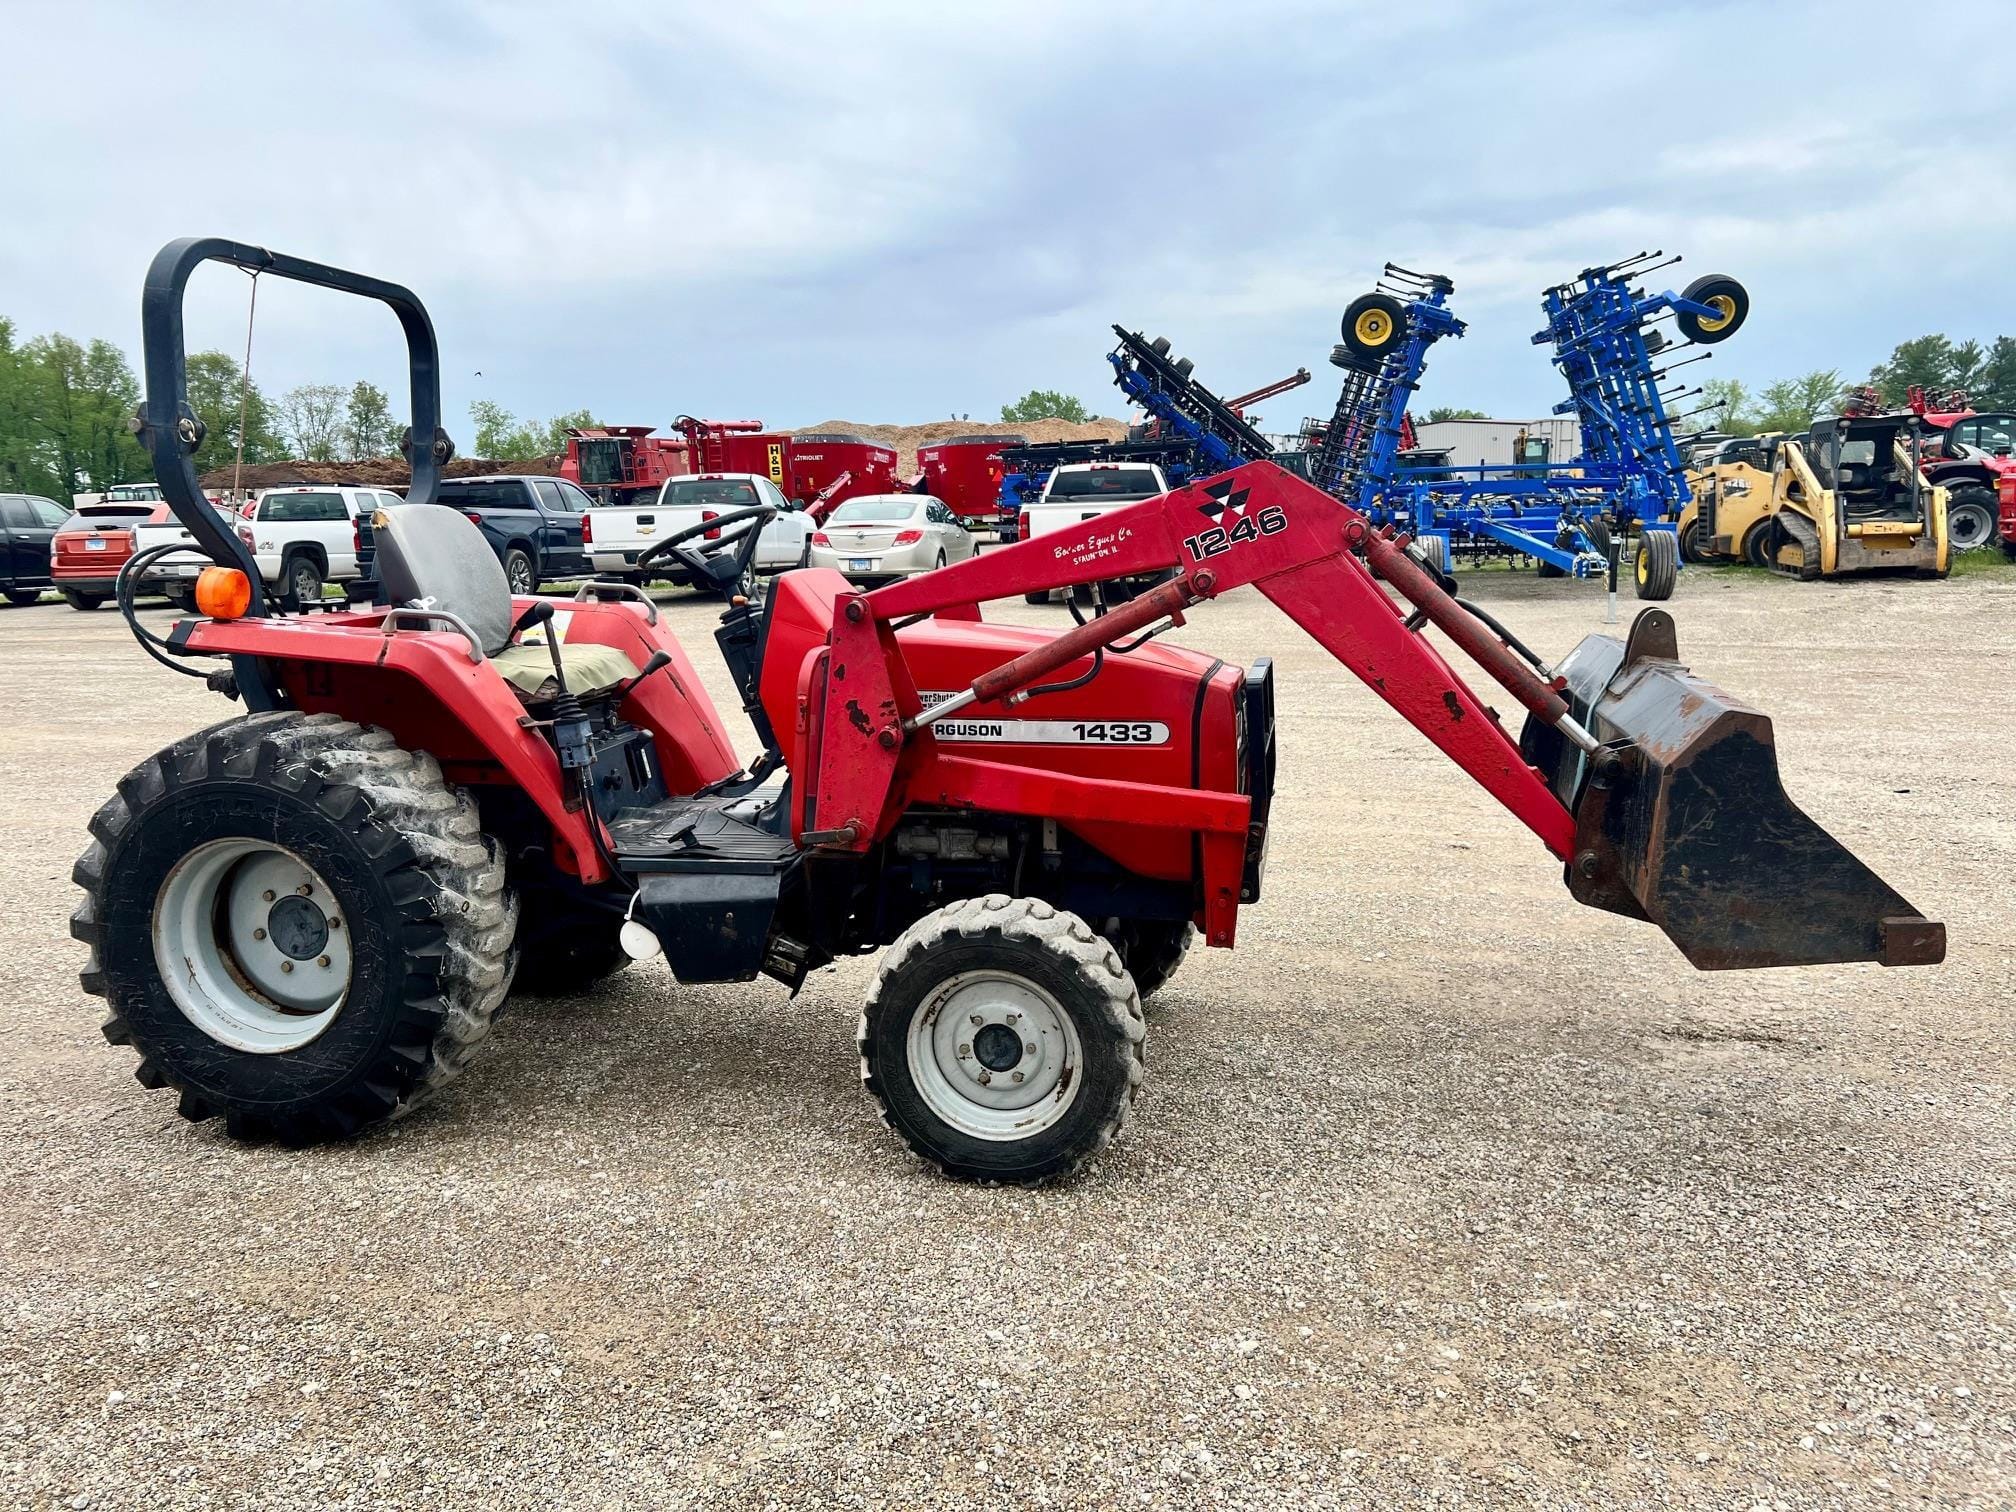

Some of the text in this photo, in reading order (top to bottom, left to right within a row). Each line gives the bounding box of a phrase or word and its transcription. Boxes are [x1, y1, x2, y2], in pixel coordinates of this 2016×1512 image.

[1183, 505, 1287, 562] 1246
[931, 723, 1003, 737] RGUSON
[1072, 724, 1152, 742] 1433
